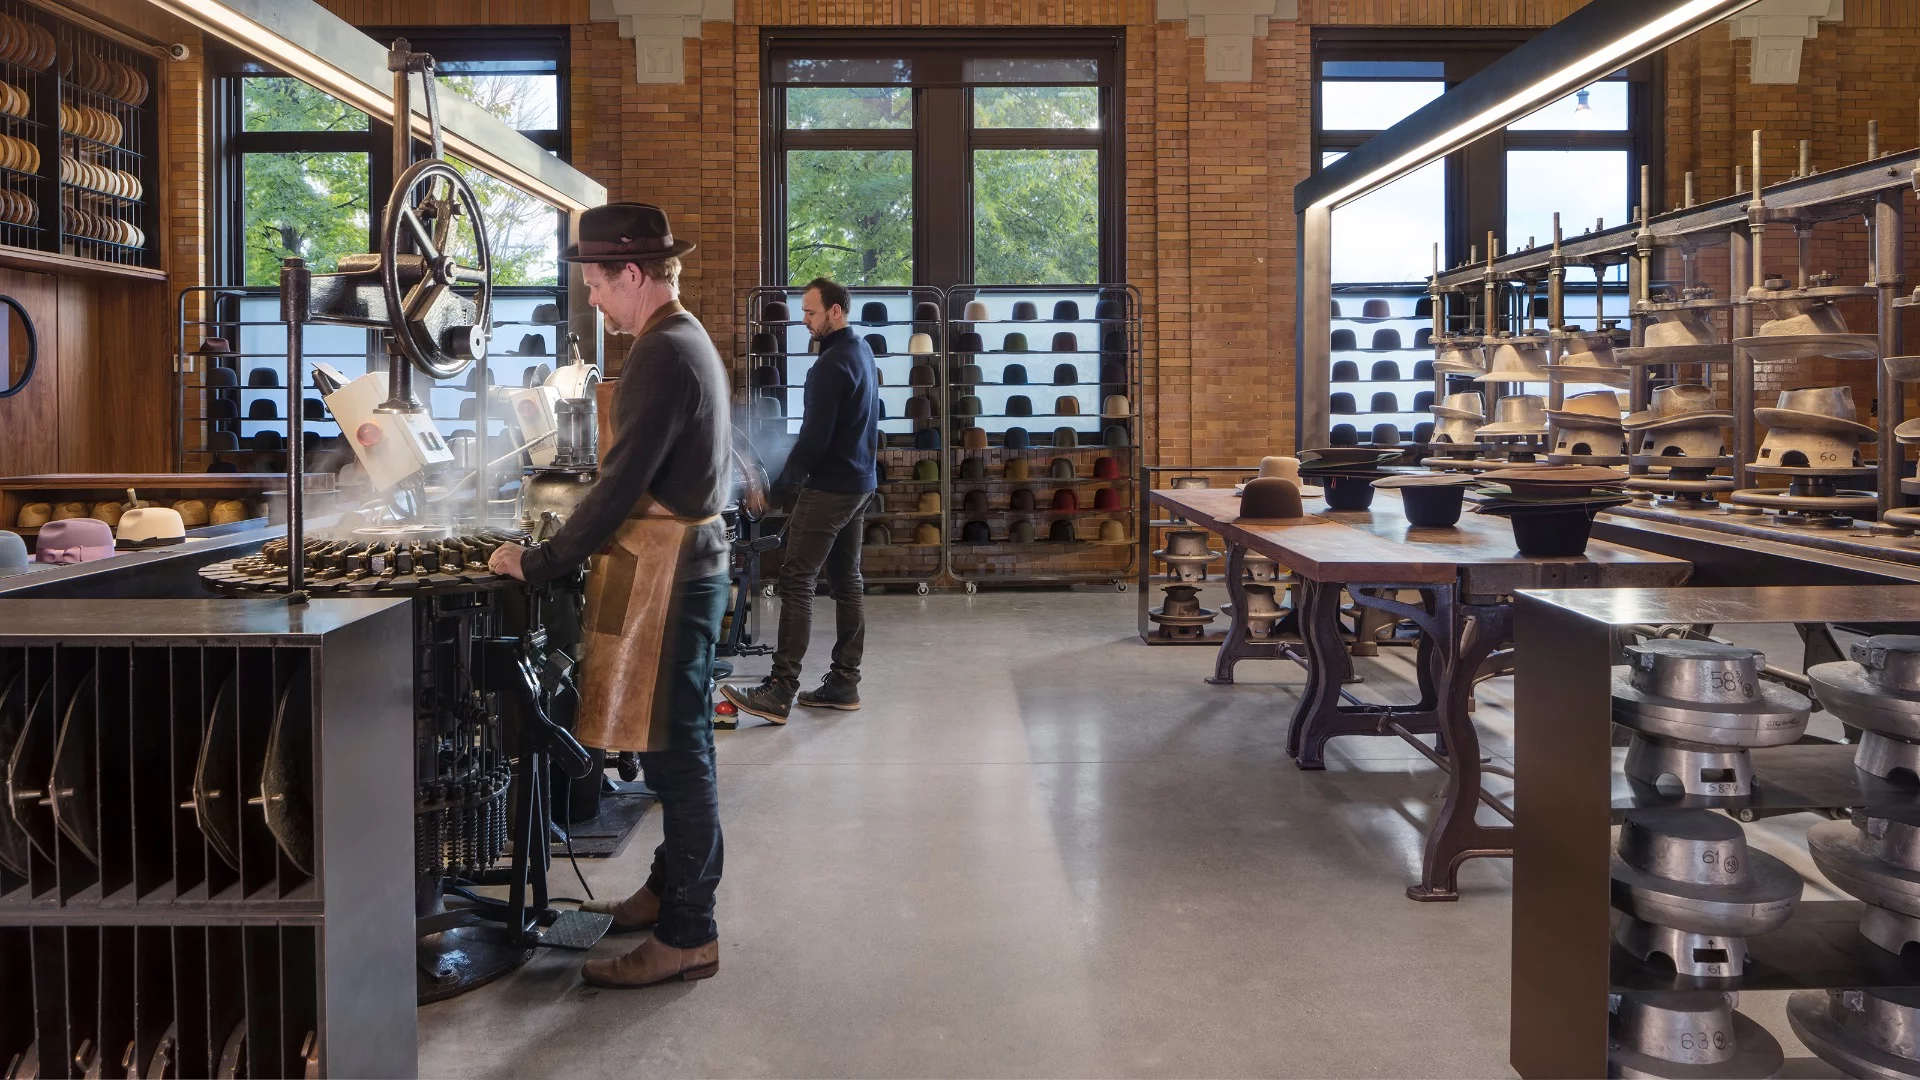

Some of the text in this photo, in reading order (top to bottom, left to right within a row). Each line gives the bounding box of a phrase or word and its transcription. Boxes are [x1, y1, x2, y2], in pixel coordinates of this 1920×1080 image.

[1820, 452, 1837, 462] 60
[1702, 850, 1719, 864] 61
[1708, 964, 1721, 975] 61
[1681, 1032, 1709, 1050] 63
